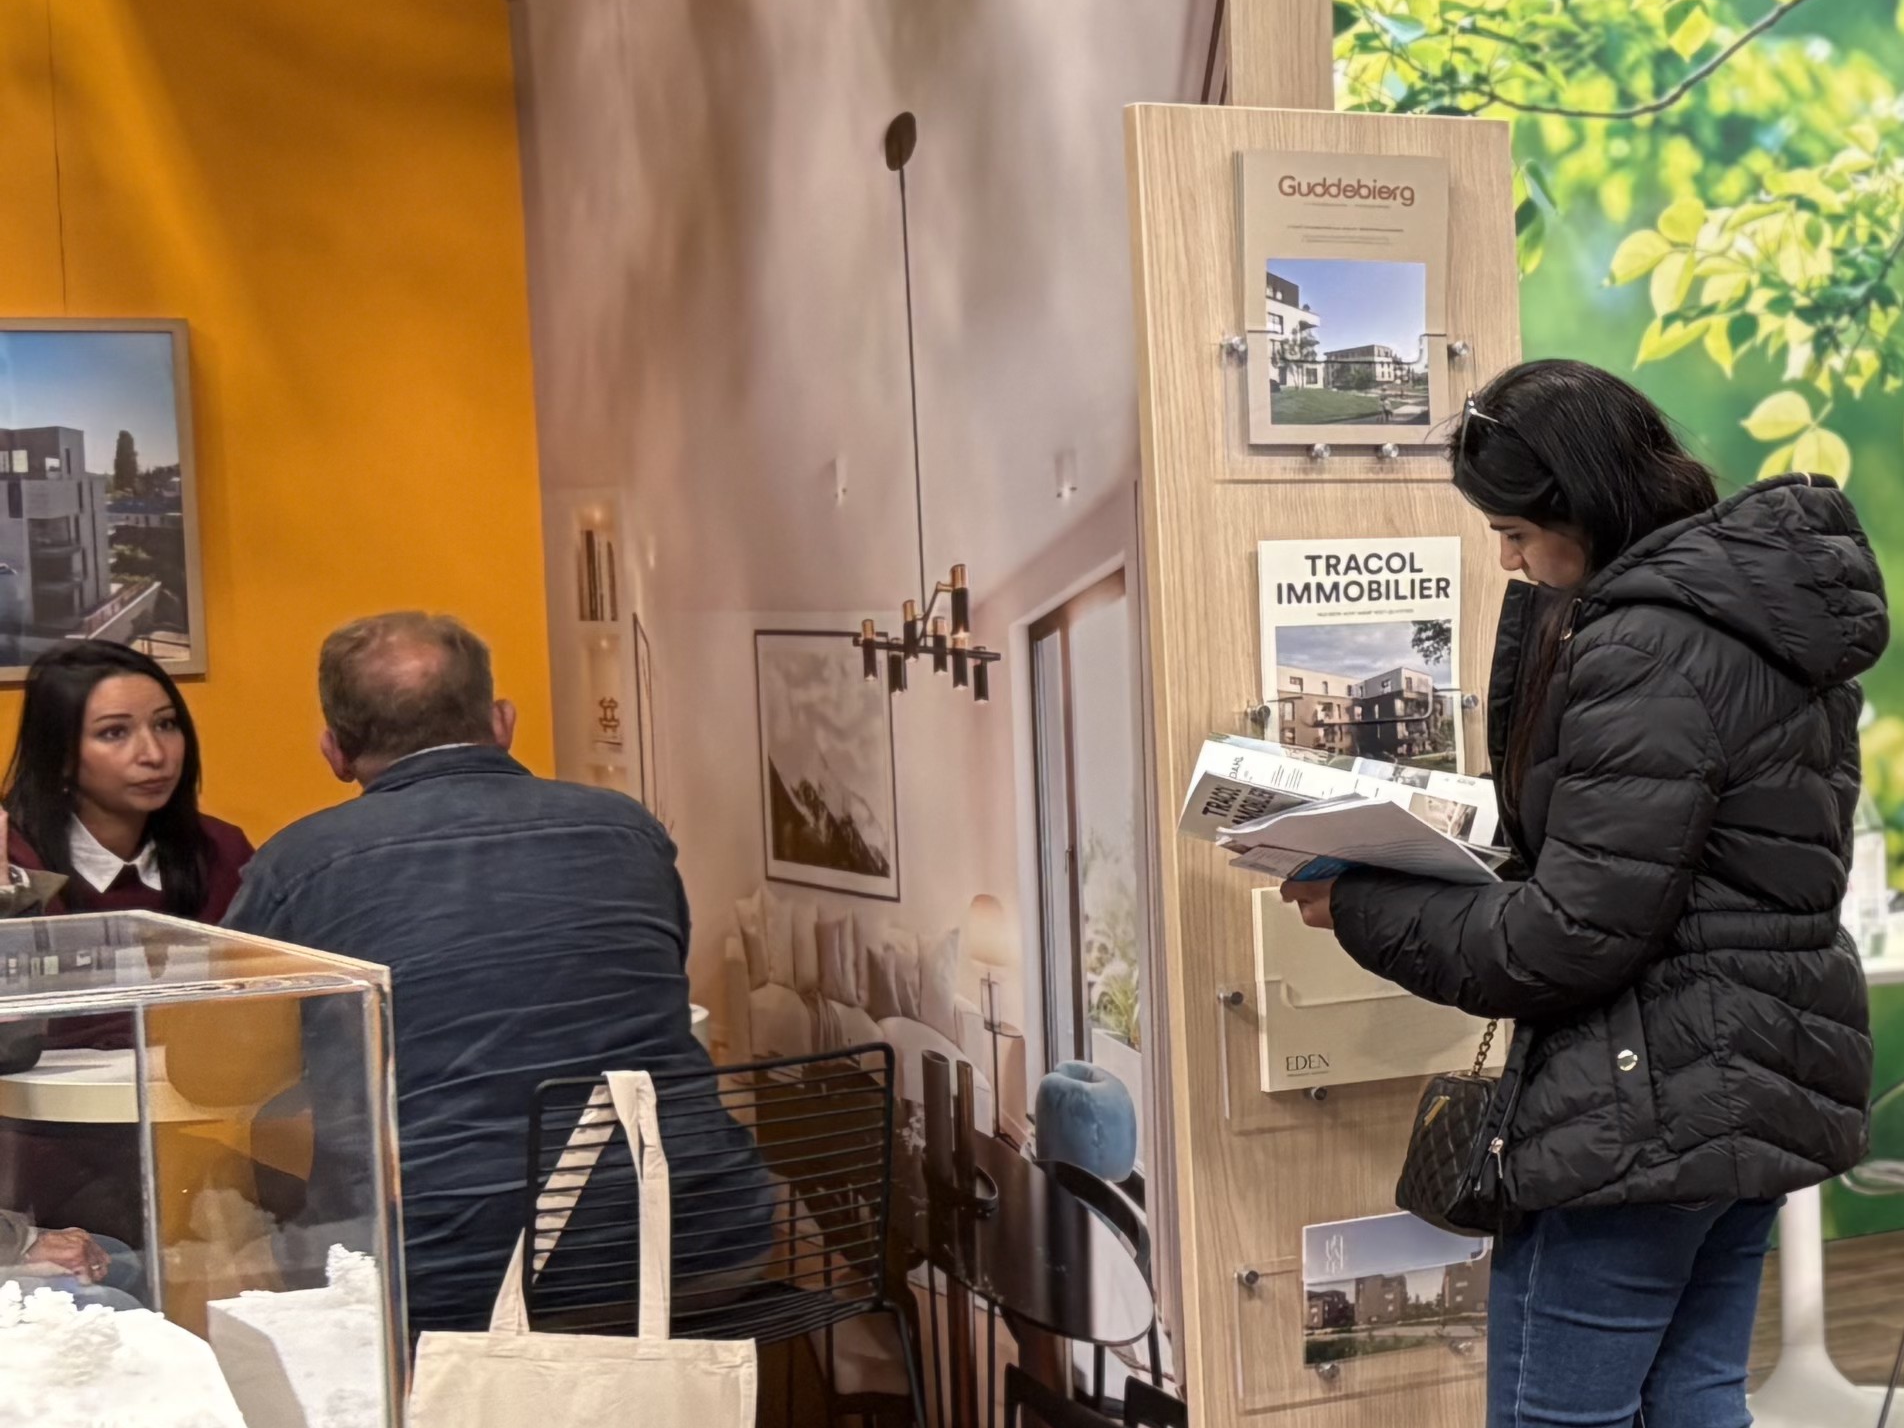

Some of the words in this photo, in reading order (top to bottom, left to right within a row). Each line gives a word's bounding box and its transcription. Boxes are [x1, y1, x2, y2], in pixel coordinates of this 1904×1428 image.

[1278, 175, 1415, 207] Guddebierg
[1304, 552, 1423, 577] TRACOL
[1277, 577, 1451, 604] IMMOBILIER
[1286, 1054, 1330, 1071] EDEN
